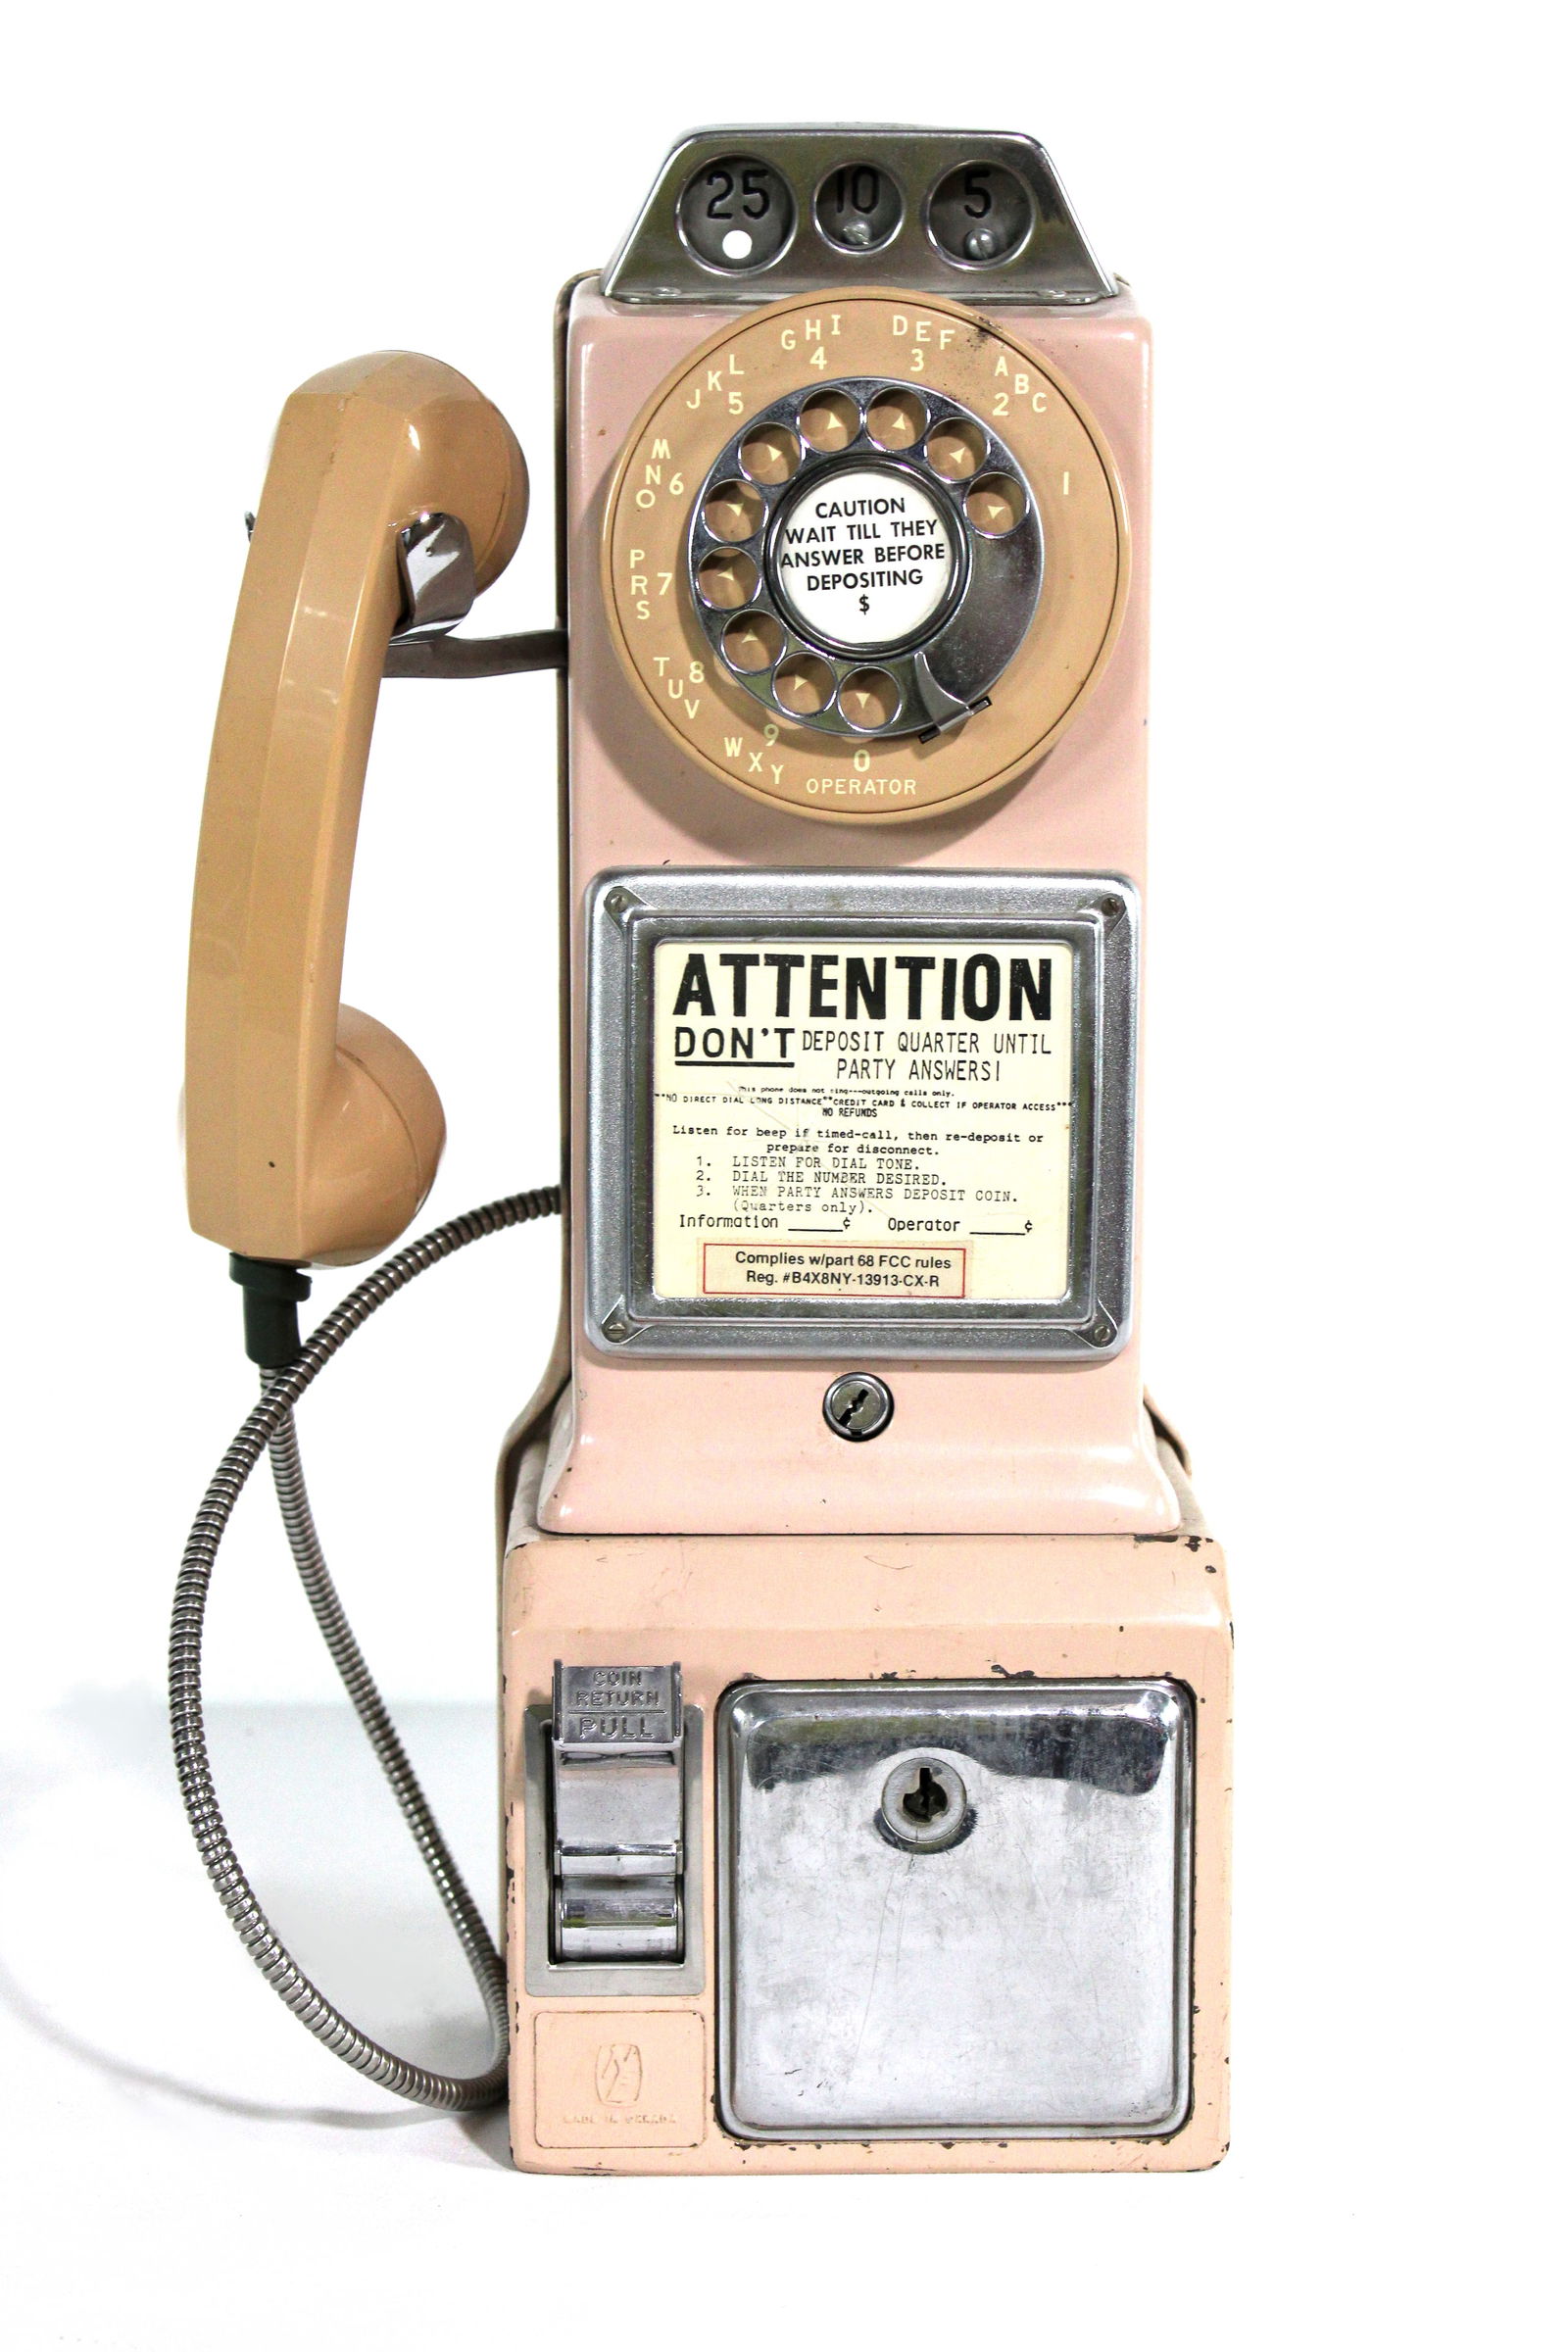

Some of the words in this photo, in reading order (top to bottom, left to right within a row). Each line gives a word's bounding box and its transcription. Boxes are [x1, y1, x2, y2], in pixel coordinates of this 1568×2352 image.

[706, 169, 771, 221] 25
[835, 165, 881, 215] 10
[963, 170, 992, 219] 5
[809, 346, 827, 370] 4
[910, 348, 925, 372] 3
[728, 392, 744, 415] 5
[992, 393, 1009, 416] 2
[668, 472, 684, 495] 6
[815, 497, 906, 518] CAUTION
[785, 525, 836, 545] WAIT
[847, 522, 881, 540] TILL
[890, 519, 938, 537] THEY
[781, 548, 864, 568] ANSWER
[874, 543, 946, 564] BEFORE
[657, 572, 673, 595] 7
[807, 568, 923, 591] DEPOSITING
[858, 593, 870, 615] $
[689, 661, 705, 683] 8
[763, 723, 779, 746] 9
[806, 777, 917, 796] OPERATOR
[672, 953, 1053, 1022] ATTENTION
[674, 1026, 796, 1059] DON'T
[802, 1029, 885, 1053] DEPOSIT
[897, 1031, 981, 1054] QUARTER
[994, 1032, 1053, 1055] UNTIL
[836, 1057, 896, 1080] PARTY
[907, 1058, 1002, 1082] ANSWERS!
[822, 1107, 834, 1117] NO
[838, 1107, 878, 1118] REFUNDS
[900, 1098, 906, 1107] &
[971, 1102, 1017, 1110] OPERATOR
[672, 1125, 718, 1136] Listen
[726, 1126, 749, 1136] for
[756, 1127, 787, 1139] beep
[795, 1128, 809, 1138] if
[817, 1129, 899, 1142] timed-call,
[907, 1130, 938, 1141] then
[945, 1132, 1021, 1144] re-deposit
[1028, 1134, 1044, 1143] or
[766, 1143, 819, 1154] prepare
[827, 1144, 850, 1153] for
[857, 1145, 940, 1155] disconnect.
[697, 1155, 711, 1167] 1.
[732, 1155, 787, 1167] LISTEN
[796, 1156, 821, 1168] FOR
[833, 1157, 867, 1169] DIAL
[876, 1158, 919, 1170] TONE.
[696, 1169, 710, 1182] 2.
[732, 1170, 768, 1182] DIAL
[778, 1170, 805, 1182] THE
[813, 1171, 866, 1184] NUMBER
[876, 1172, 947, 1186] DESIRED.
[697, 1185, 710, 1197] 3.
[732, 1185, 767, 1197] WHEN
[777, 1186, 821, 1198] PARTY
[831, 1187, 894, 1200] ANSWERS
[904, 1189, 965, 1200] DEPOSIT
[975, 1190, 1017, 1202] COIN.
[733, 1198, 812, 1212] (Quarters
[821, 1200, 872, 1215] only).
[679, 1214, 779, 1229] Information
[888, 1217, 960, 1232] Operator
[735, 1250, 805, 1267] Complies
[808, 1252, 854, 1268] w/part
[858, 1255, 874, 1267] 68
[879, 1255, 911, 1268] FCC
[915, 1256, 952, 1269] rules
[746, 1270, 778, 1286] Reg.
[782, 1271, 940, 1287] #B4X8NY-13913-CX-R
[593, 1670, 643, 1687] COIN
[576, 1690, 661, 1707] RETURN
[579, 1716, 656, 1740] PULL
